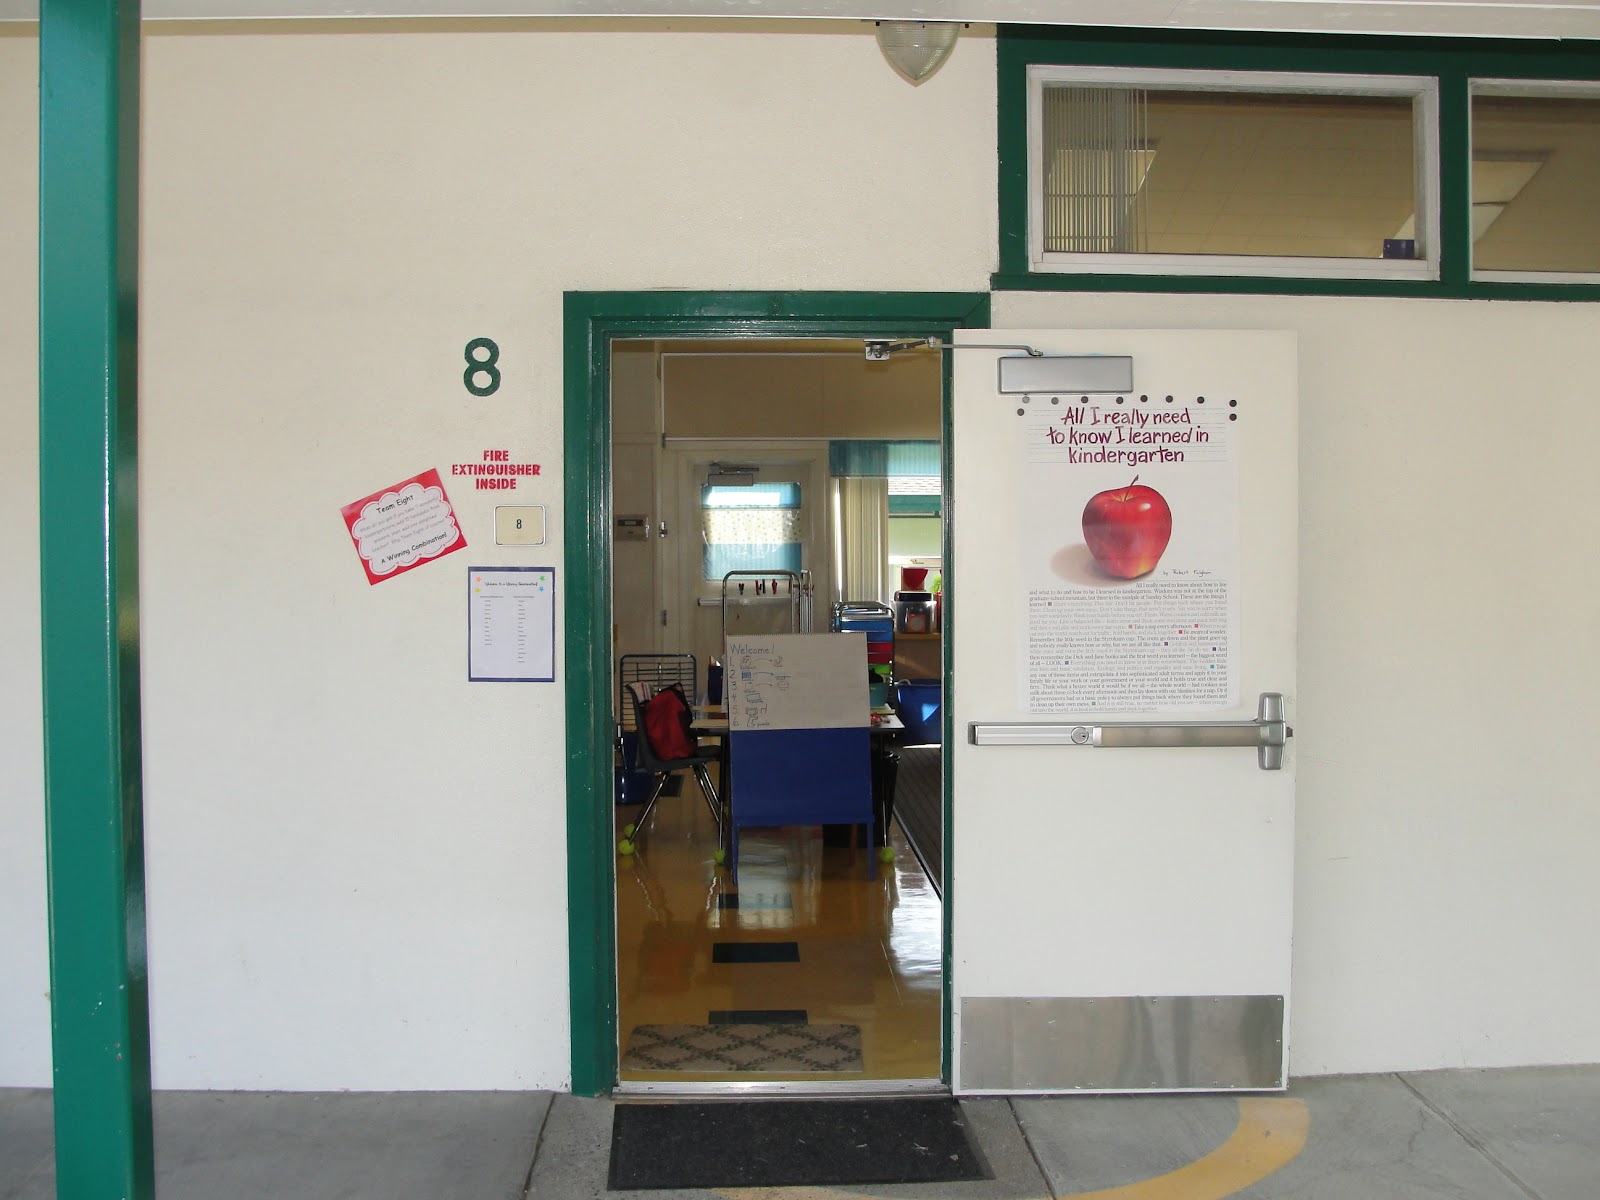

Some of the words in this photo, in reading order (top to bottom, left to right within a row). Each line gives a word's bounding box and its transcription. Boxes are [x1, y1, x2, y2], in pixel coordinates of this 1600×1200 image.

[463, 337, 501, 397] 8
[1061, 406, 1084, 425] All
[1090, 406, 1100, 425] I
[1104, 408, 1149, 428] really
[1154, 407, 1190, 424] need
[1046, 427, 1065, 444] to
[1069, 427, 1112, 445] know
[1115, 426, 1125, 444] I
[1129, 427, 1192, 444] learned
[1196, 426, 1209, 443] in
[483, 450, 509, 462] FIRE
[1068, 446, 1184, 466] kindergarten
[452, 464, 541, 476] EXTINGUISHER
[476, 478, 517, 490] INSIDE
[376, 504, 394, 514] Team
[396, 495, 414, 506] Eight
[516, 518, 522, 530] 8
[387, 550, 410, 562] Winning
[412, 532, 447, 551] Combination!
[730, 644, 774, 654] Welcome!
